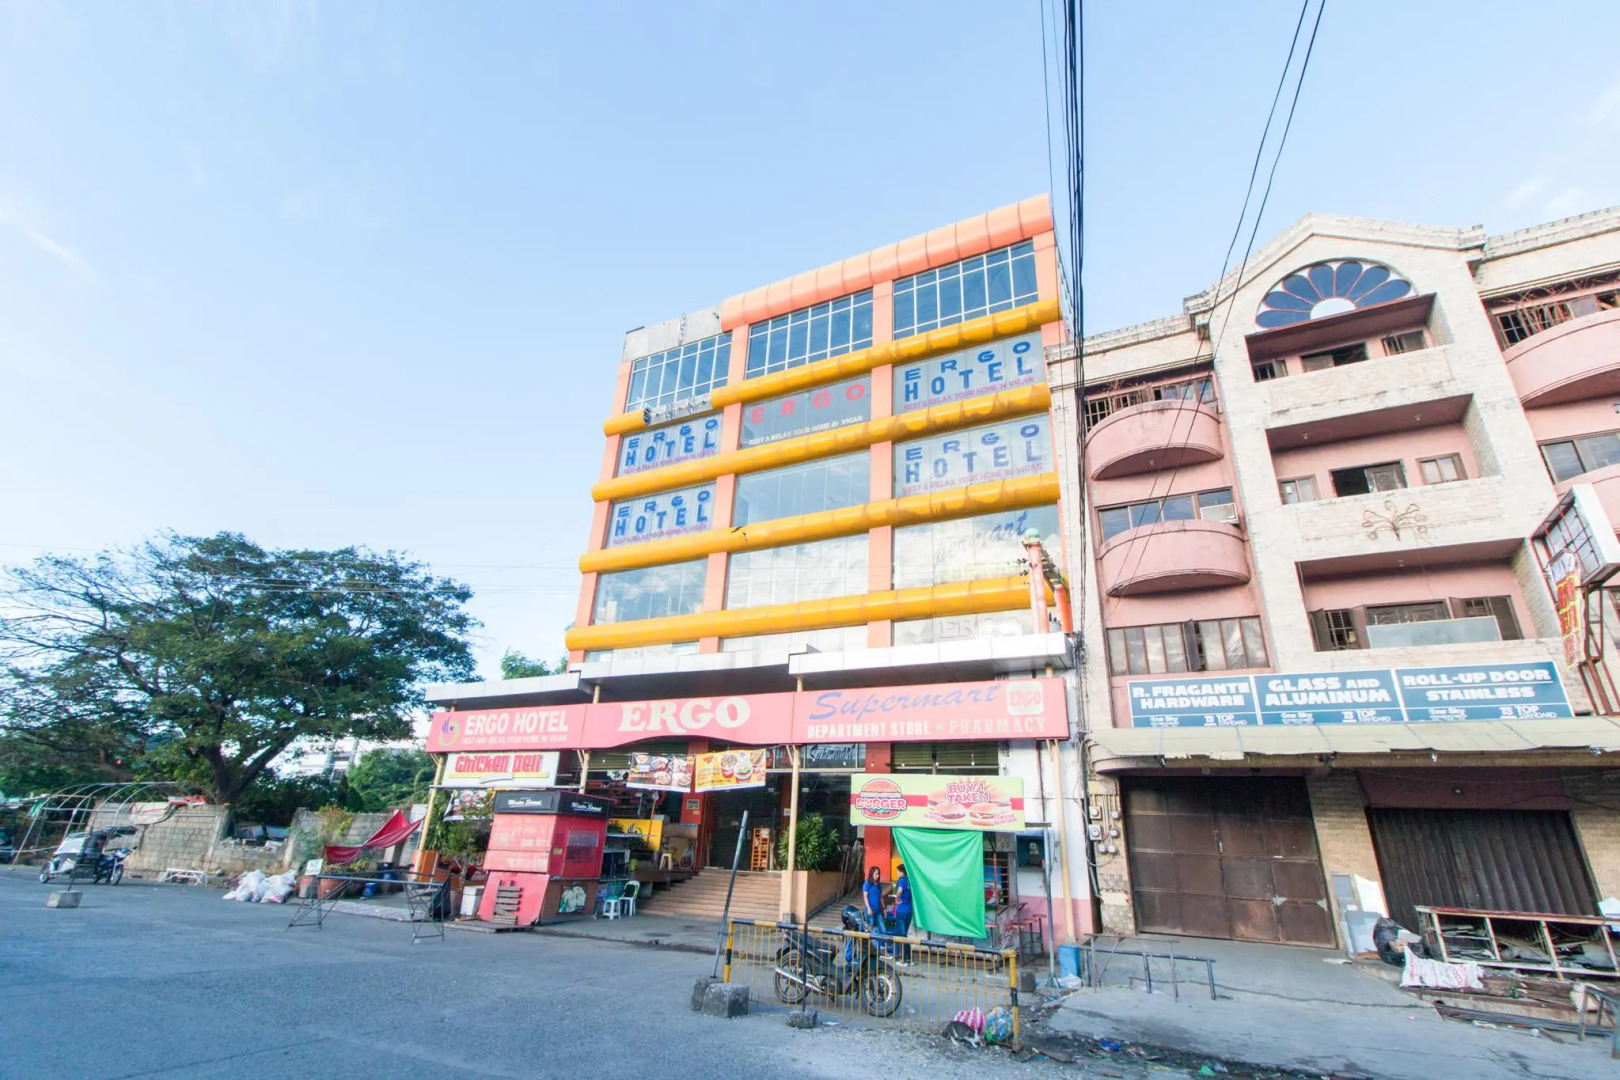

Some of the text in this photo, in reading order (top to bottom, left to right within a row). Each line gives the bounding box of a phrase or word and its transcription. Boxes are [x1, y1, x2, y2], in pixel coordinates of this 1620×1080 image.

[905, 341, 1031, 381] ERGO
[905, 357, 1033, 402] HOTEL
[751, 383, 865, 424] ERGO
[904, 401, 922, 410] REST
[954, 389, 975, 401] YOUR
[976, 384, 998, 395] HOME
[1008, 376, 1034, 387] VIGAN
[628, 418, 718, 448] ERGO
[748, 437, 764, 446] REST
[771, 431, 792, 441] RELAX
[794, 426, 811, 436] YOUR
[811, 422, 830, 433] HOME
[841, 415, 863, 425] VIGAN
[625, 432, 715, 466] HOTEL
[906, 424, 1039, 461] ERGO
[906, 440, 1042, 484] HOTEL
[902, 484, 921, 495] REST
[930, 478, 956, 489] RELAX
[958, 474, 979, 485] YOUR
[980, 470, 1002, 482] HOME
[1016, 462, 1043, 474] VIGAN
[618, 490, 710, 517] ERGO
[615, 504, 707, 536] HOTEL
[1268, 677, 1380, 692] GLASS AND
[1402, 669, 1551, 686] ROLL-UP DOOR
[1009, 690, 1042, 707] ERGO
[1132, 682, 1250, 698] R. FRAGANTE
[1265, 689, 1392, 706] ALUMINUM
[1426, 687, 1535, 701] STAINLESS
[809, 683, 1001, 722] Supermart
[1141, 695, 1245, 709] HARDWARE
[1515, 705, 1539, 717] TOP
[464, 710, 569, 736] ERGO HOTEL
[617, 697, 750, 733] ERGO
[950, 717, 1047, 735] PHARMACY
[1216, 714, 1234, 725] TOP
[1355, 710, 1376, 721] TOP
[808, 720, 930, 739] DEPARTMENT STORE
[947, 791, 990, 804] TAKE 1
[948, 782, 974, 793] BUY
[856, 797, 907, 811] BURGER
